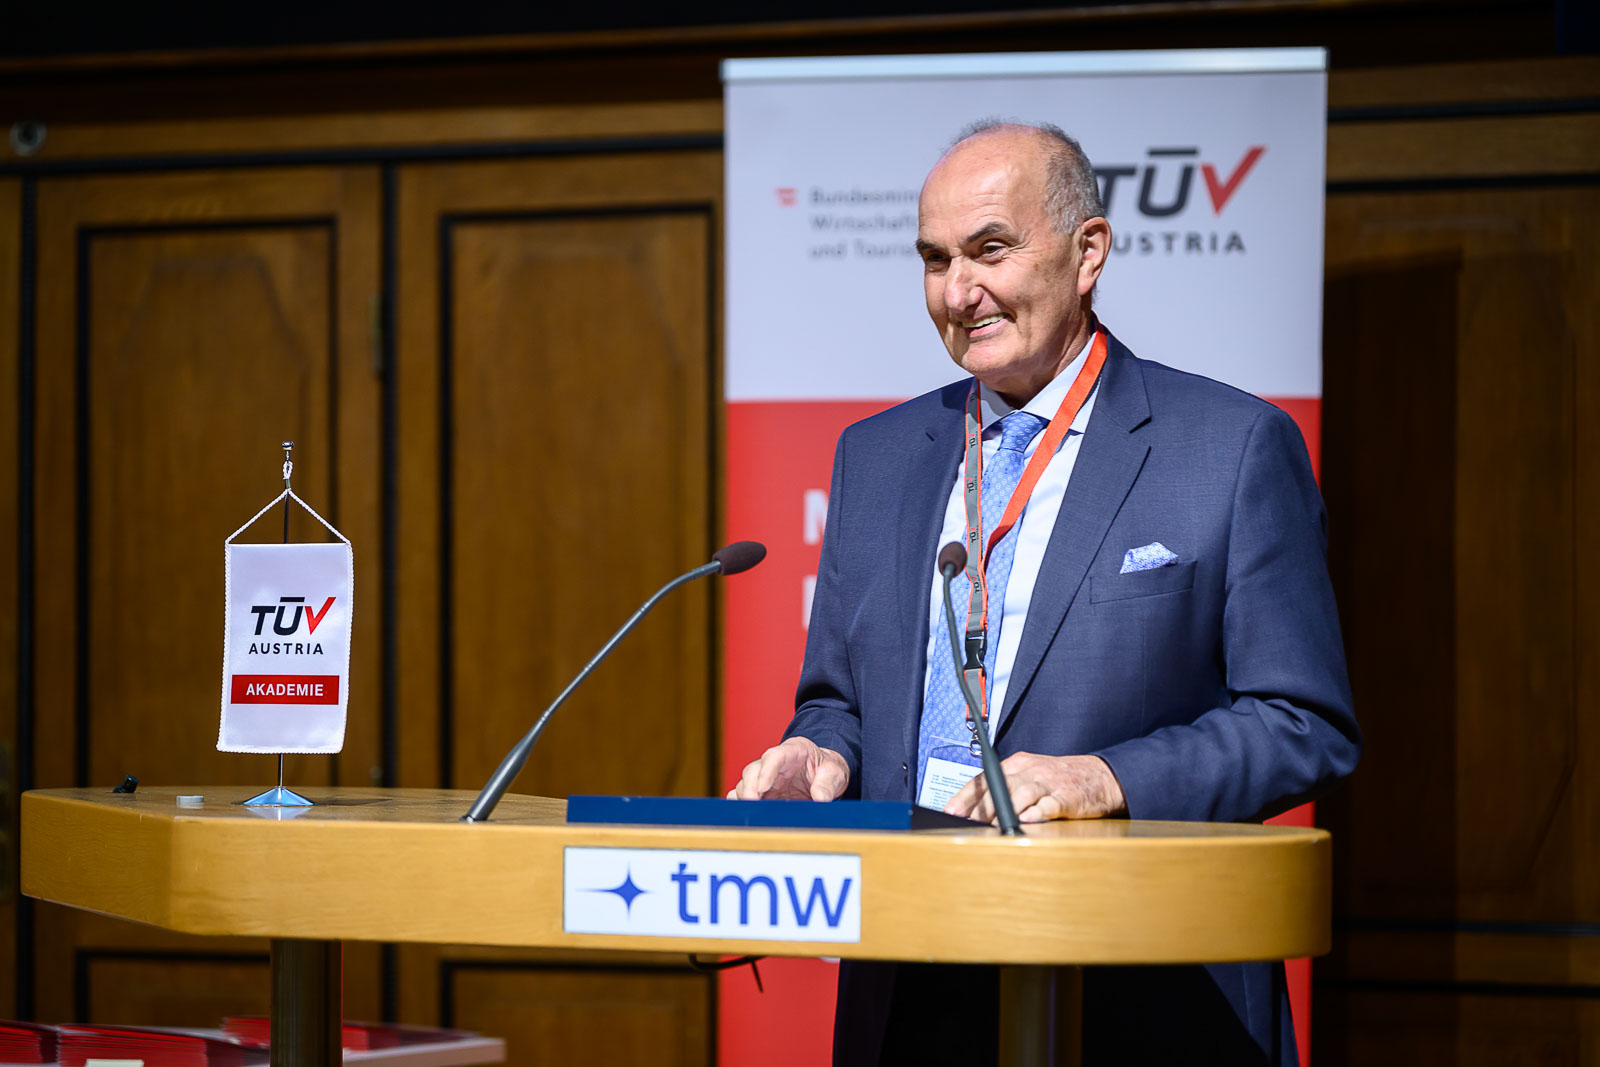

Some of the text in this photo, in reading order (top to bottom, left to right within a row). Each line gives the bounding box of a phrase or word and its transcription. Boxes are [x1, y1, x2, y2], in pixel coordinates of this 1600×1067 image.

[1111, 231, 1246, 255] USTRIA
[248, 642, 324, 655] AUSTRIA
[245, 683, 324, 697] AKADEMIE
[671, 862, 853, 928] tmw
